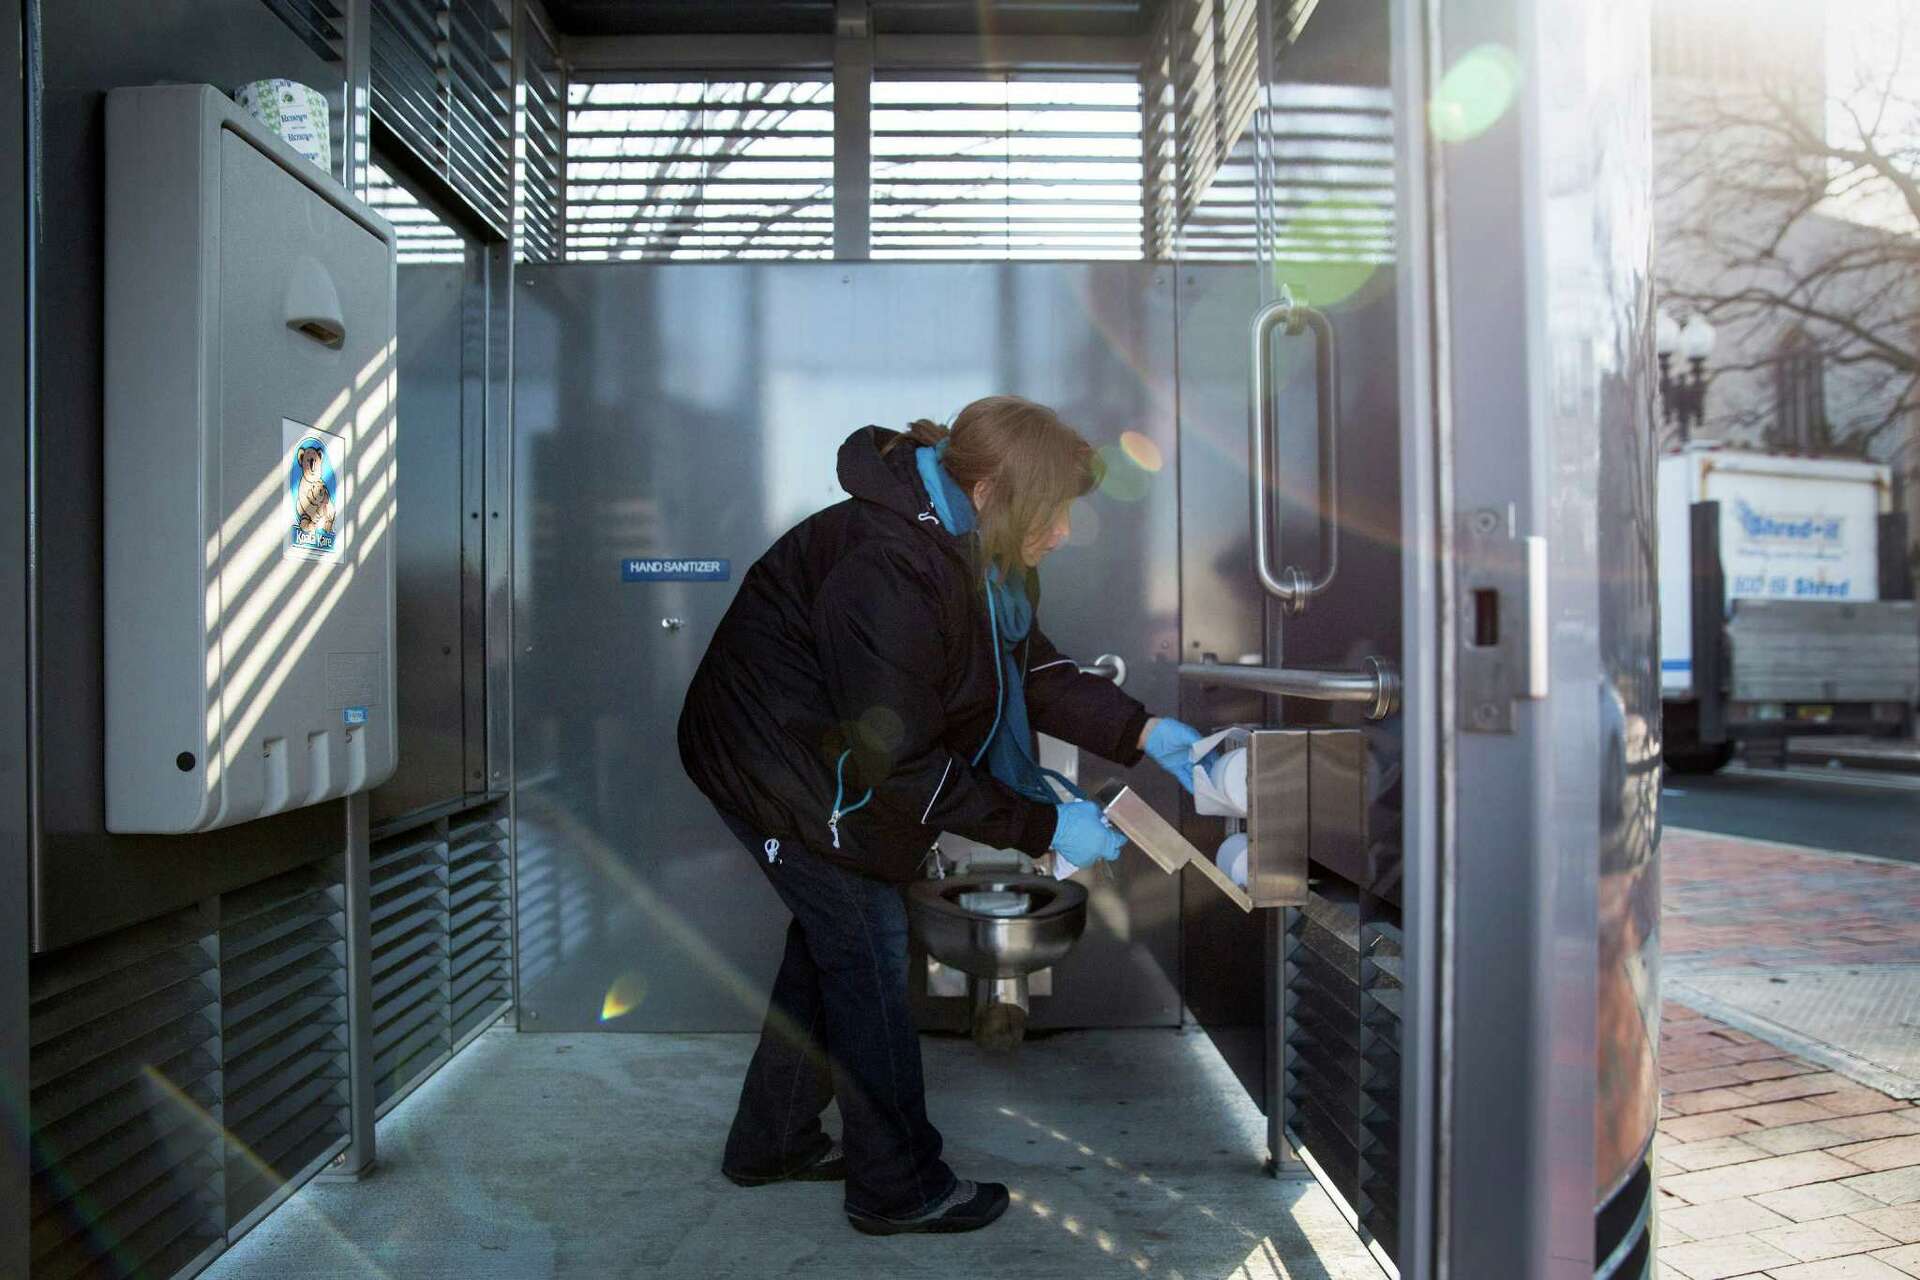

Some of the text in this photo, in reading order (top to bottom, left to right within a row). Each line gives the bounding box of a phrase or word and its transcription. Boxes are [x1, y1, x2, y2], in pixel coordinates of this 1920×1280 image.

[317, 533, 332, 547] Kare
[630, 561, 720, 573] HAND SANITIZER
